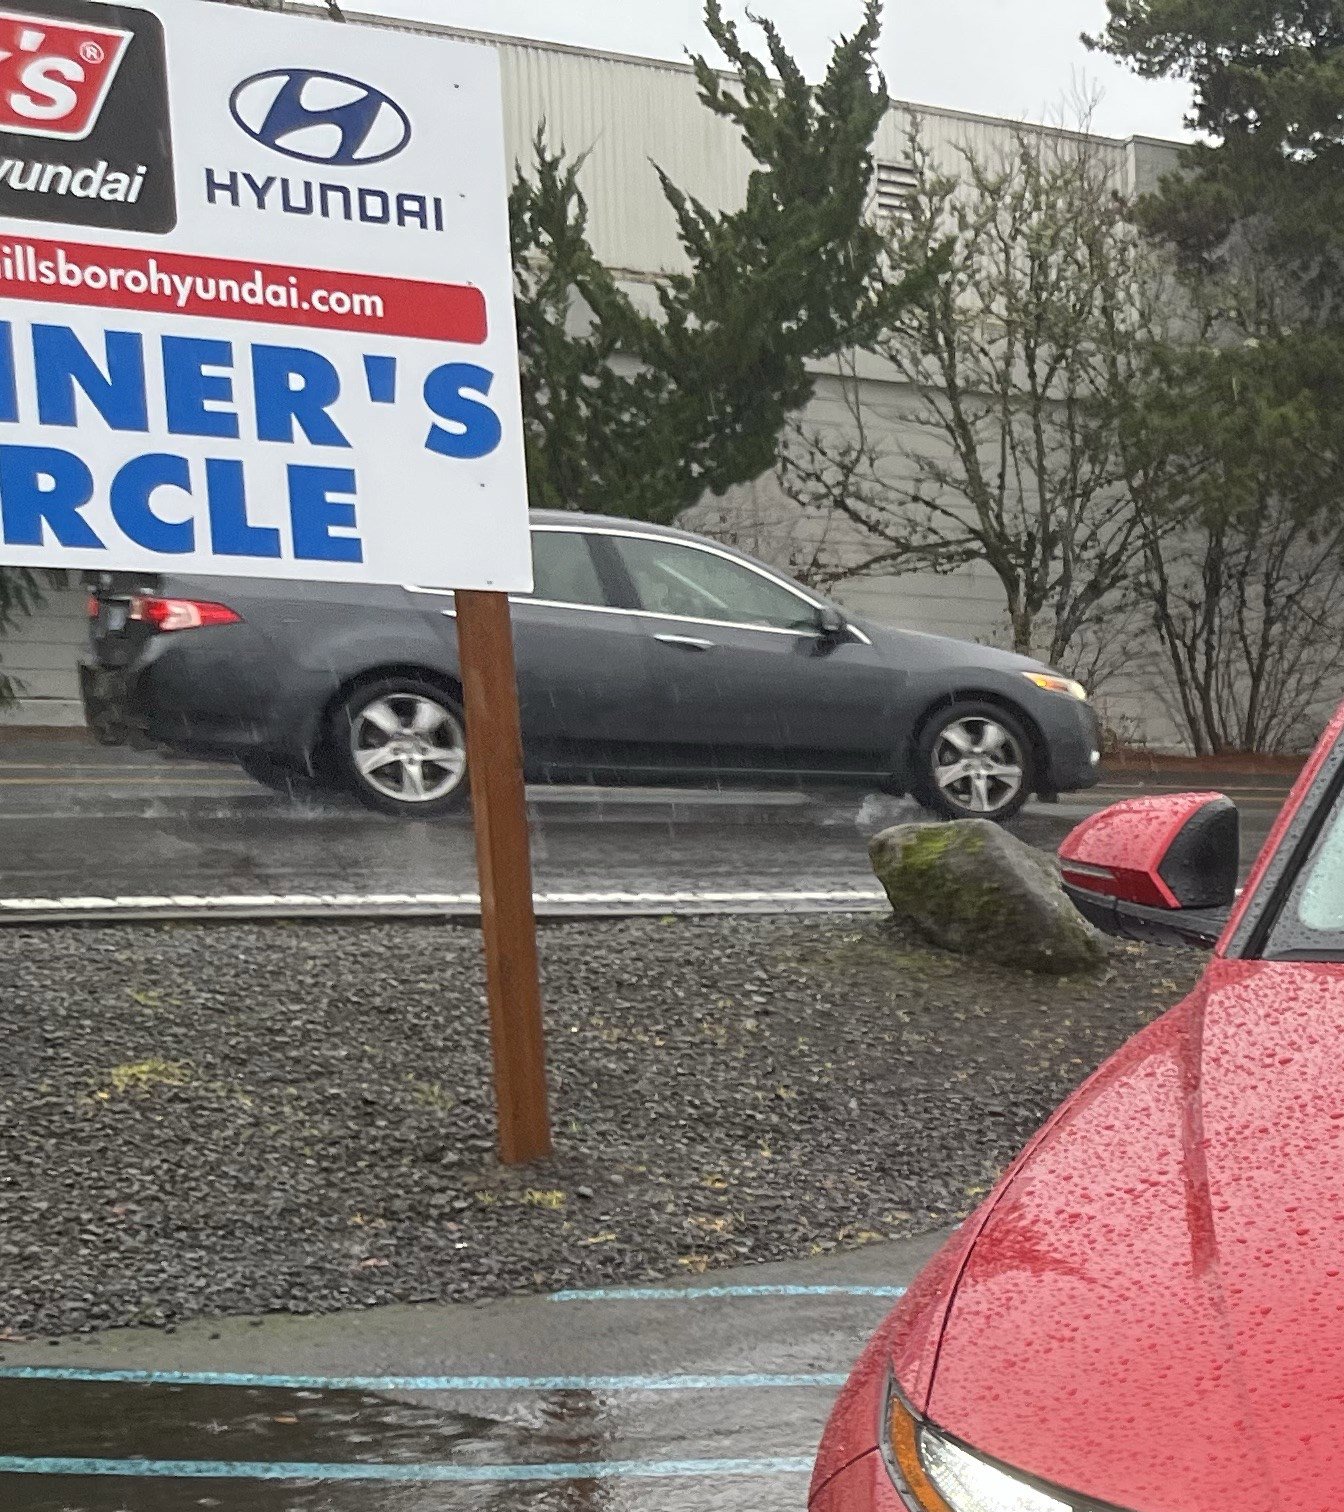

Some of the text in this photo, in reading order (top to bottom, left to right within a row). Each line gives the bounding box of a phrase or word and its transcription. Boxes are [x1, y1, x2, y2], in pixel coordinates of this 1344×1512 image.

[0, 28, 86, 120] 's
[205, 167, 445, 232] HYUNDAI
[0, 244, 385, 318] illsborohyundai.com
[0, 320, 502, 459] NER'S
[0, 444, 364, 564] RCLE
